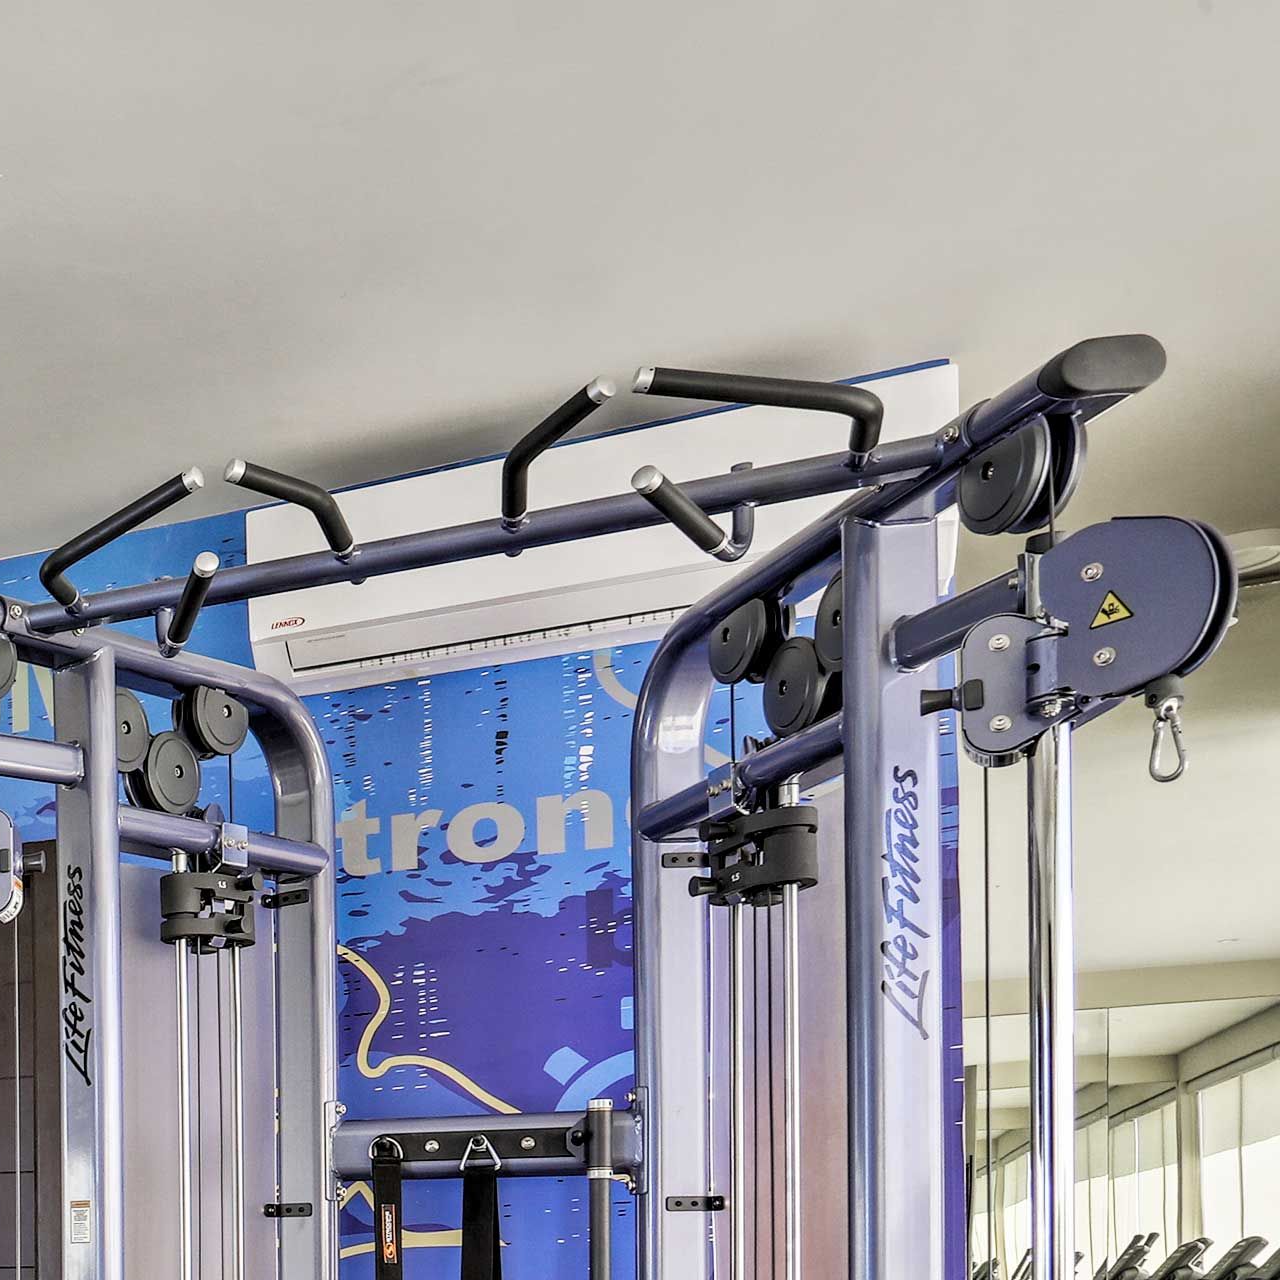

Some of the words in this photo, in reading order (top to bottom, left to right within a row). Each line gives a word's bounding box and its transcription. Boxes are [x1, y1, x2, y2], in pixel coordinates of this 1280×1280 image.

[336, 788, 632, 877] tron
[880, 764, 930, 940] Fitness
[62, 863, 92, 1004] Fitness
